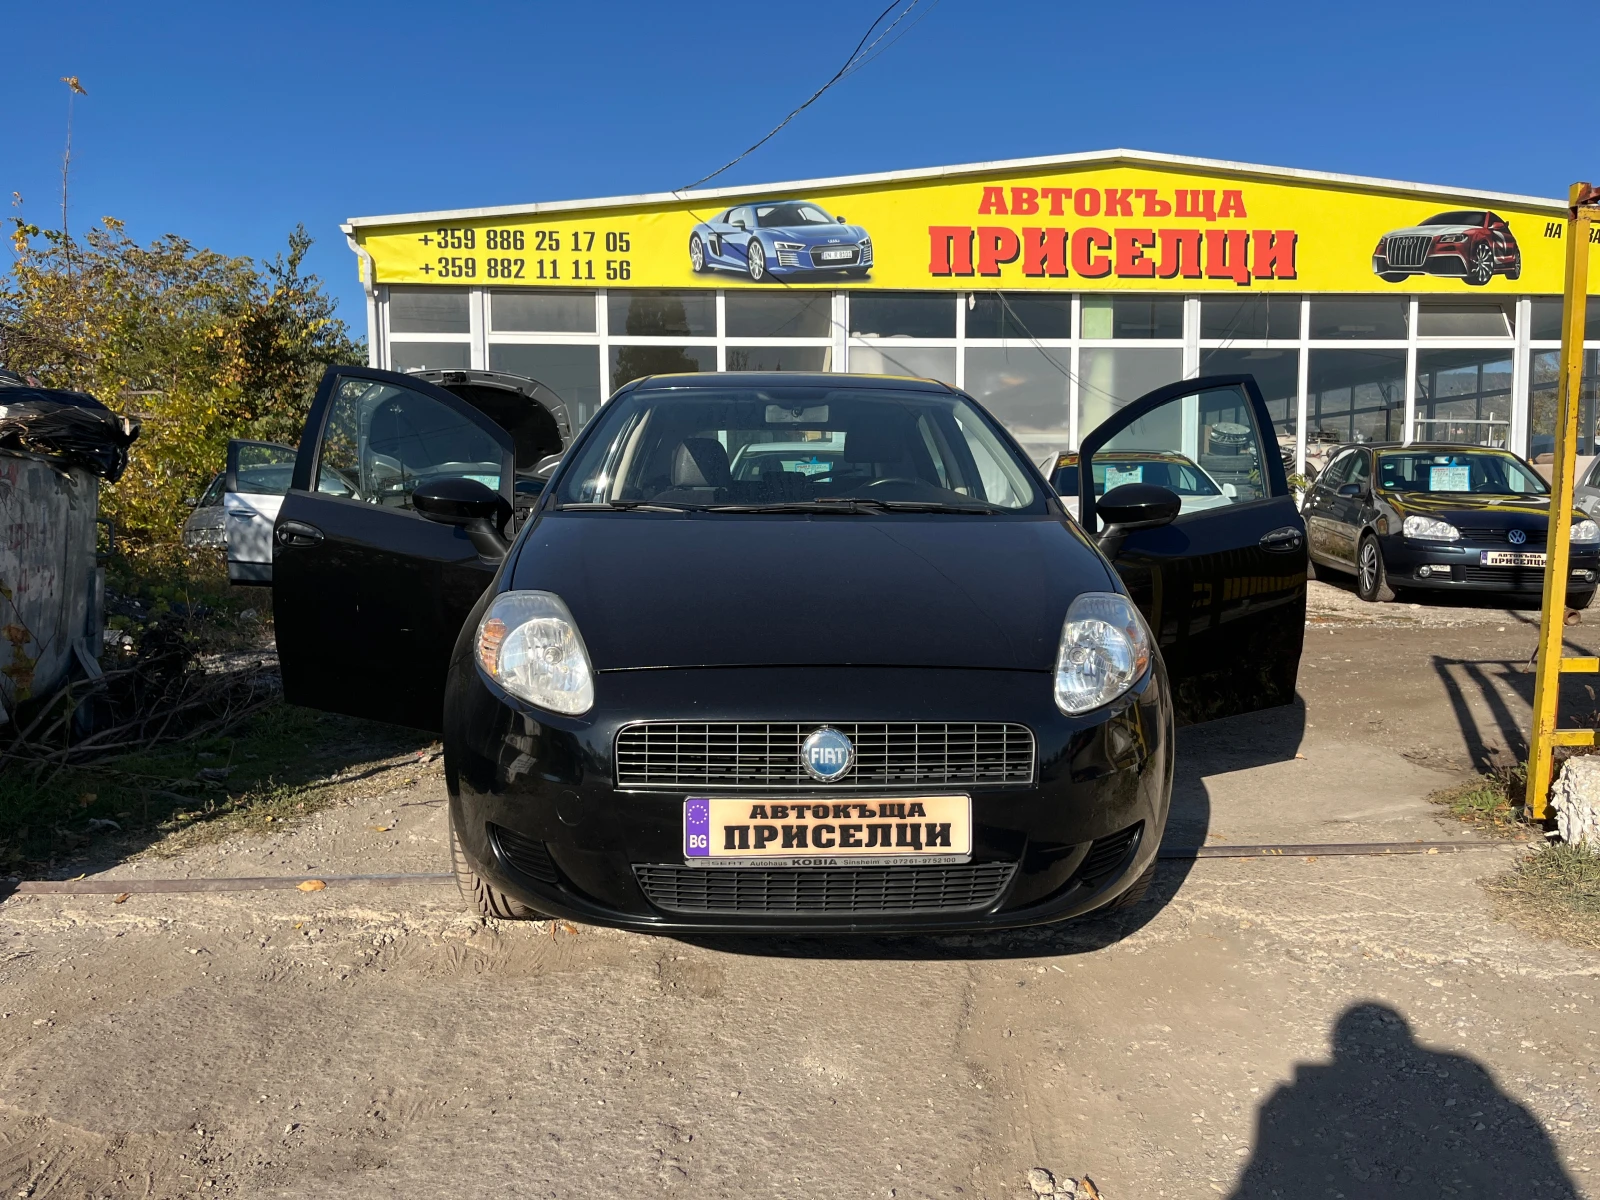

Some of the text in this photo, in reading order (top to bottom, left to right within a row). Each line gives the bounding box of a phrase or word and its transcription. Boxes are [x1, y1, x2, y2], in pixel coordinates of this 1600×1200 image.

[977, 186, 1248, 221] АВТОКЪЩА
[418, 228, 630, 252] +359 886 25 17 05
[927, 226, 1298, 286] ПРИСЕЛЦИ
[419, 257, 631, 280] +359 882 11 11 56
[811, 747, 844, 764] FIAT
[749, 802, 926, 819] АВТОКЪЩА
[689, 834, 707, 848] BG
[723, 823, 952, 850] ПРИСЕЛЦИ
